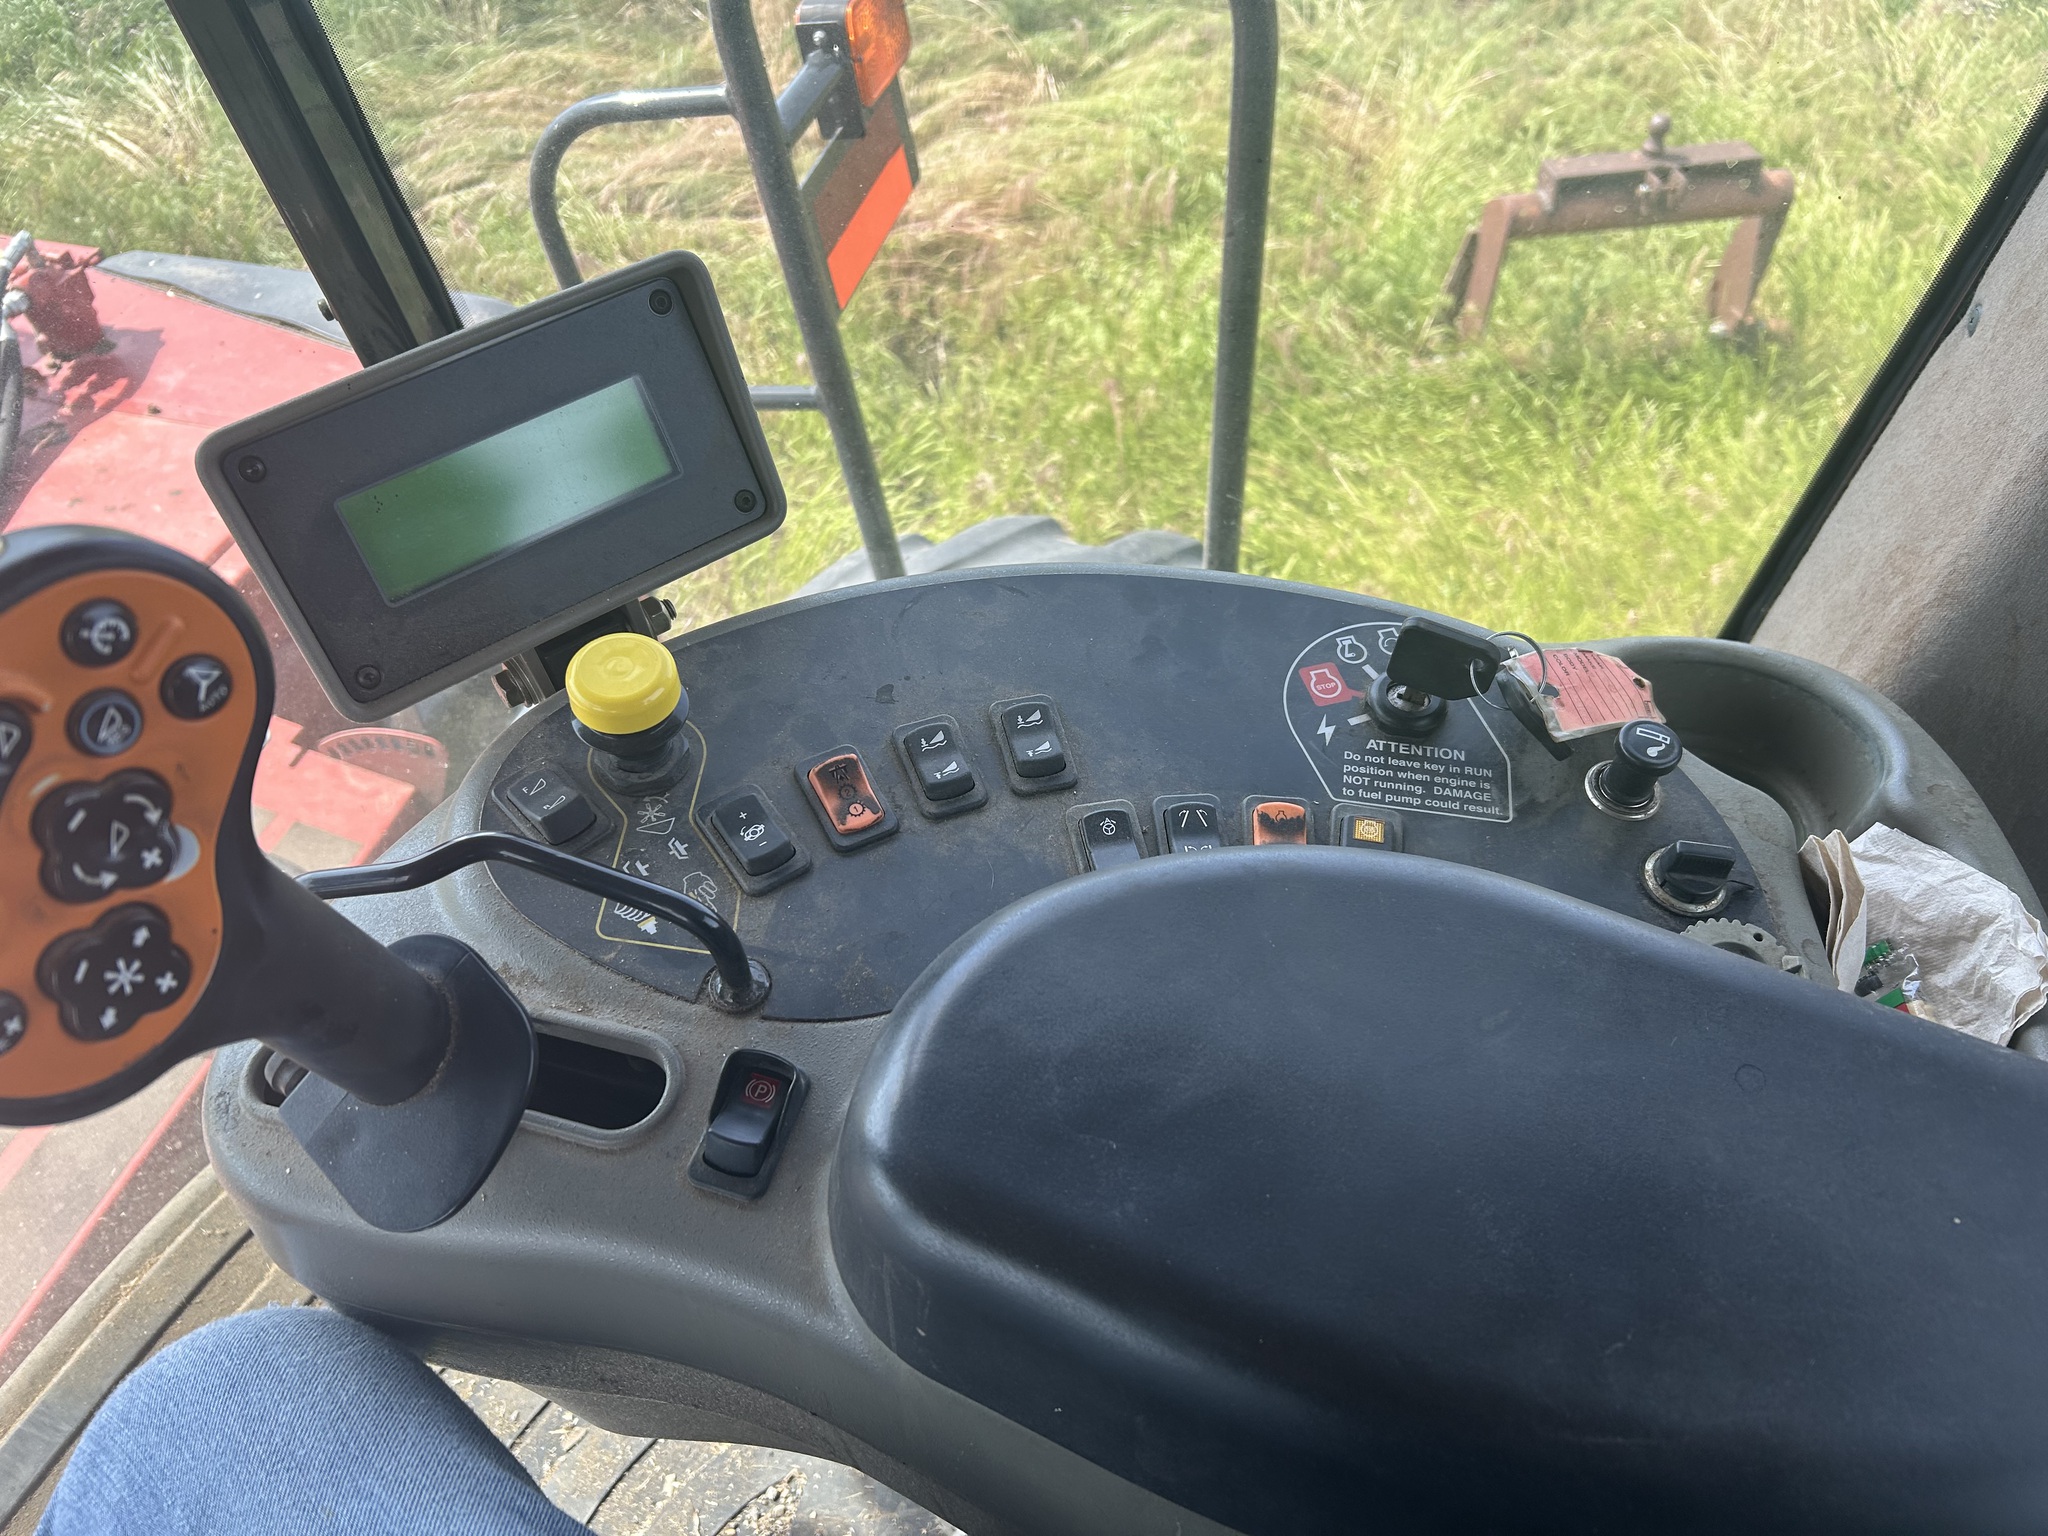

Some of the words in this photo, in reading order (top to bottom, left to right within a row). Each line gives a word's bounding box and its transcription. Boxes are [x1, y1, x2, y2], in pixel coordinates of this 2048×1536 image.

[1553, 654, 1570, 676] COLOR
[1563, 653, 1578, 670] BODY
[1316, 682, 1336, 690] STOP
[1366, 739, 1465, 761] ATTENTION
[1343, 751, 1361, 761] Do
[1364, 753, 1384, 764] not
[1388, 757, 1421, 769] leave
[1424, 761, 1446, 773] key
[1449, 765, 1461, 775] in
[1464, 767, 1493, 778] RUN
[1343, 764, 1394, 777] position
[1397, 770, 1430, 782] when
[1433, 776, 1477, 788] engine
[1480, 780, 1491, 790] is
[1343, 775, 1371, 786] NOT
[1374, 780, 1426, 795] running.
[1433, 786, 1492, 801] DAMAGE
[1342, 787, 1355, 796] to
[1358, 789, 1382, 800] fuel
[1385, 793, 1421, 806] pump
[1424, 798, 1460, 810] could
[1463, 804, 1503, 816] result.
[754, 1084, 768, 1097] P
